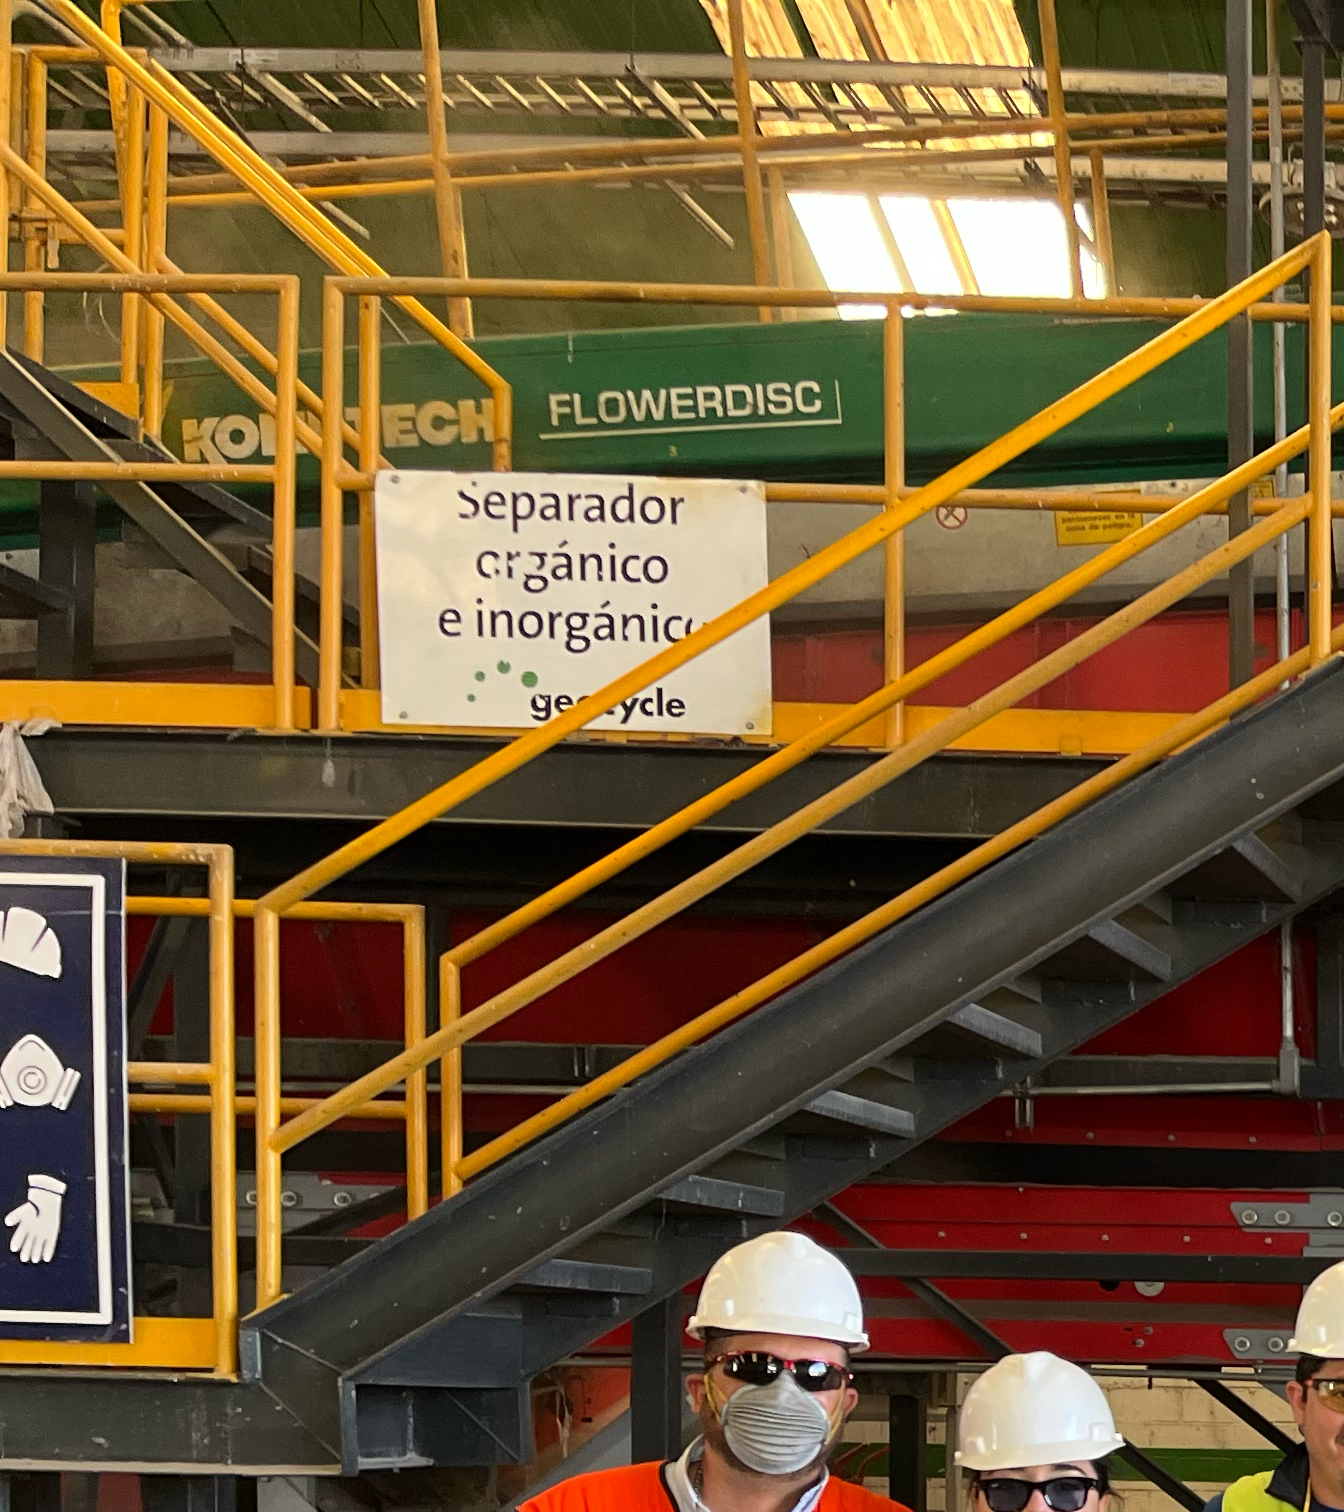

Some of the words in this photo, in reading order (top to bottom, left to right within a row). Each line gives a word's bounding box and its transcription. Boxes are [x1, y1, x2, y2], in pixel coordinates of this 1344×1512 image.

[548, 380, 822, 428] FLOWERDISC
[458, 482, 685, 533] Separador
[477, 540, 669, 594] orgánico
[438, 608, 462, 637] e
[475, 598, 704, 653] inorgánic
[530, 687, 686, 724] geycle
